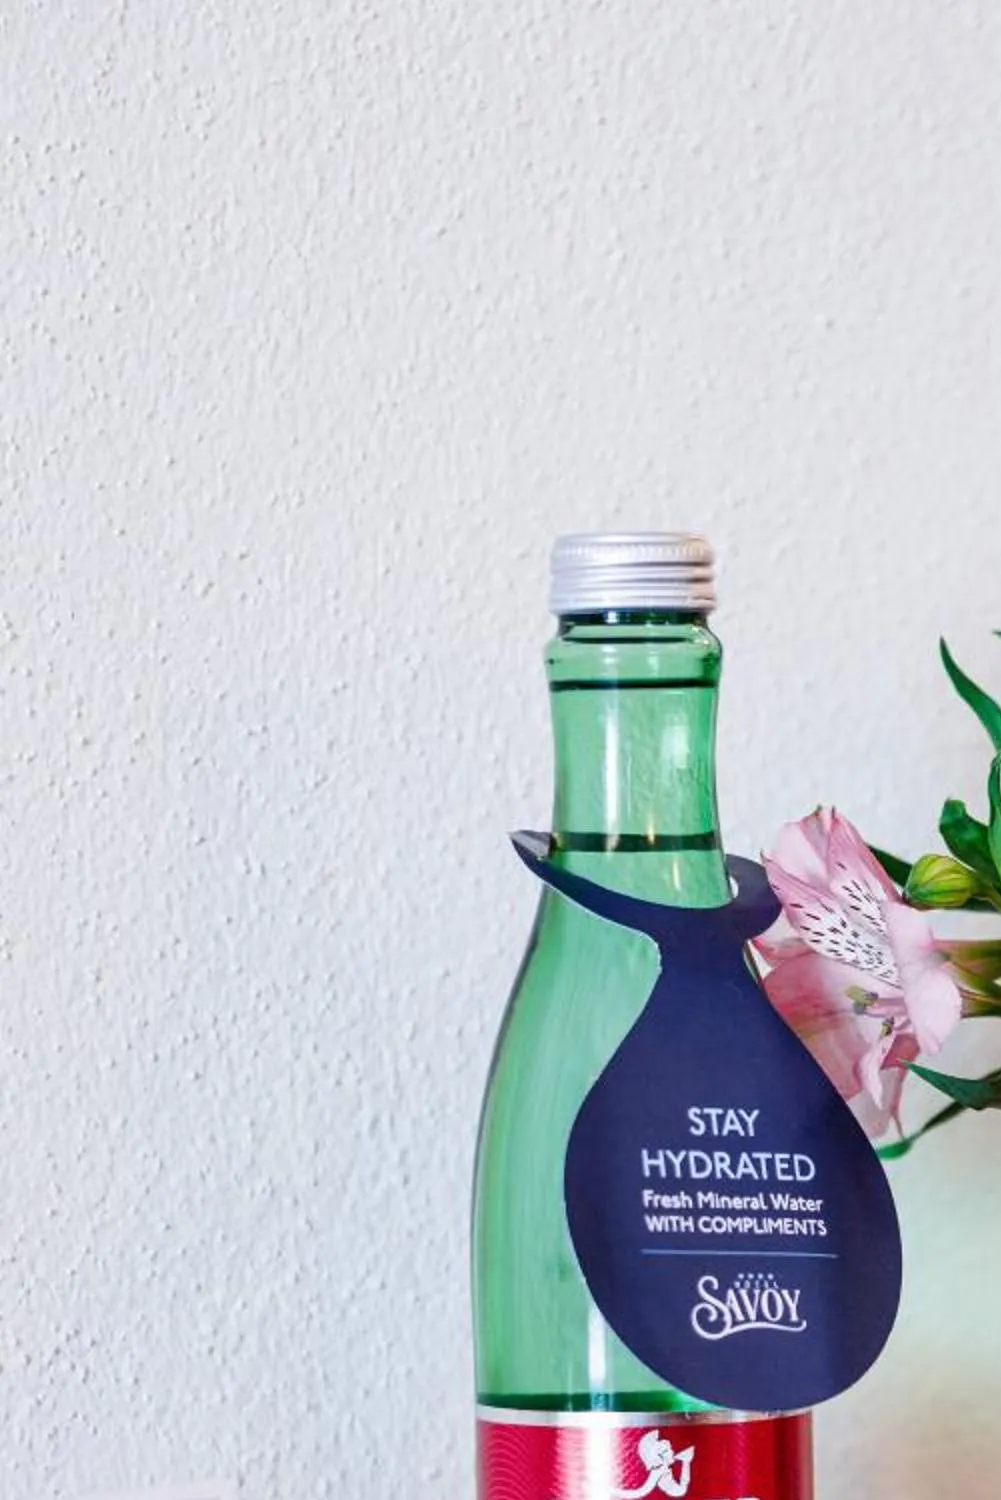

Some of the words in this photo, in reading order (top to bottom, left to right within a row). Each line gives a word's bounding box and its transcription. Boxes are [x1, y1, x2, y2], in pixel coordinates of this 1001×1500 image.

[687, 1106, 760, 1137] STAY
[640, 1149, 816, 1181] HYDRATED
[641, 1189, 692, 1209] Fresh
[697, 1190, 768, 1210] Mineral
[769, 1192, 823, 1212] Water
[644, 1214, 695, 1233] WITH
[698, 1215, 828, 1237] COMPLIMENTS
